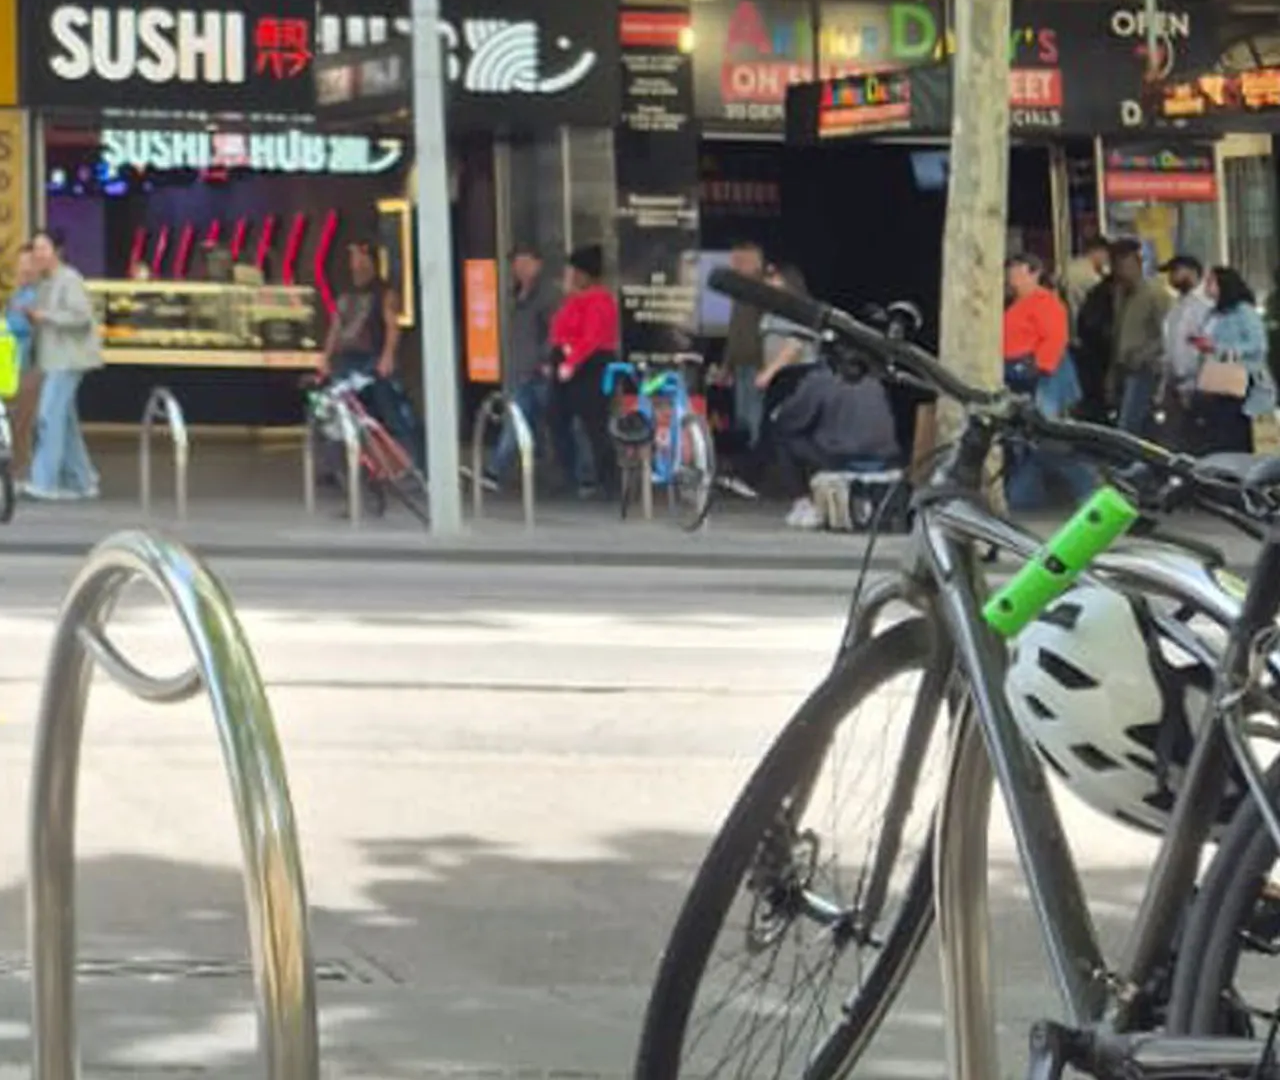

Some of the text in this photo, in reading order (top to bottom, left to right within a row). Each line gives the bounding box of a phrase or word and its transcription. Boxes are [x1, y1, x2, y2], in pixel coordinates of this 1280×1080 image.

[49, 5, 245, 83] SUSHI
[732, 70, 779, 95] ON
[99, 128, 212, 171] SUSHI
[249, 128, 327, 172] HUB
